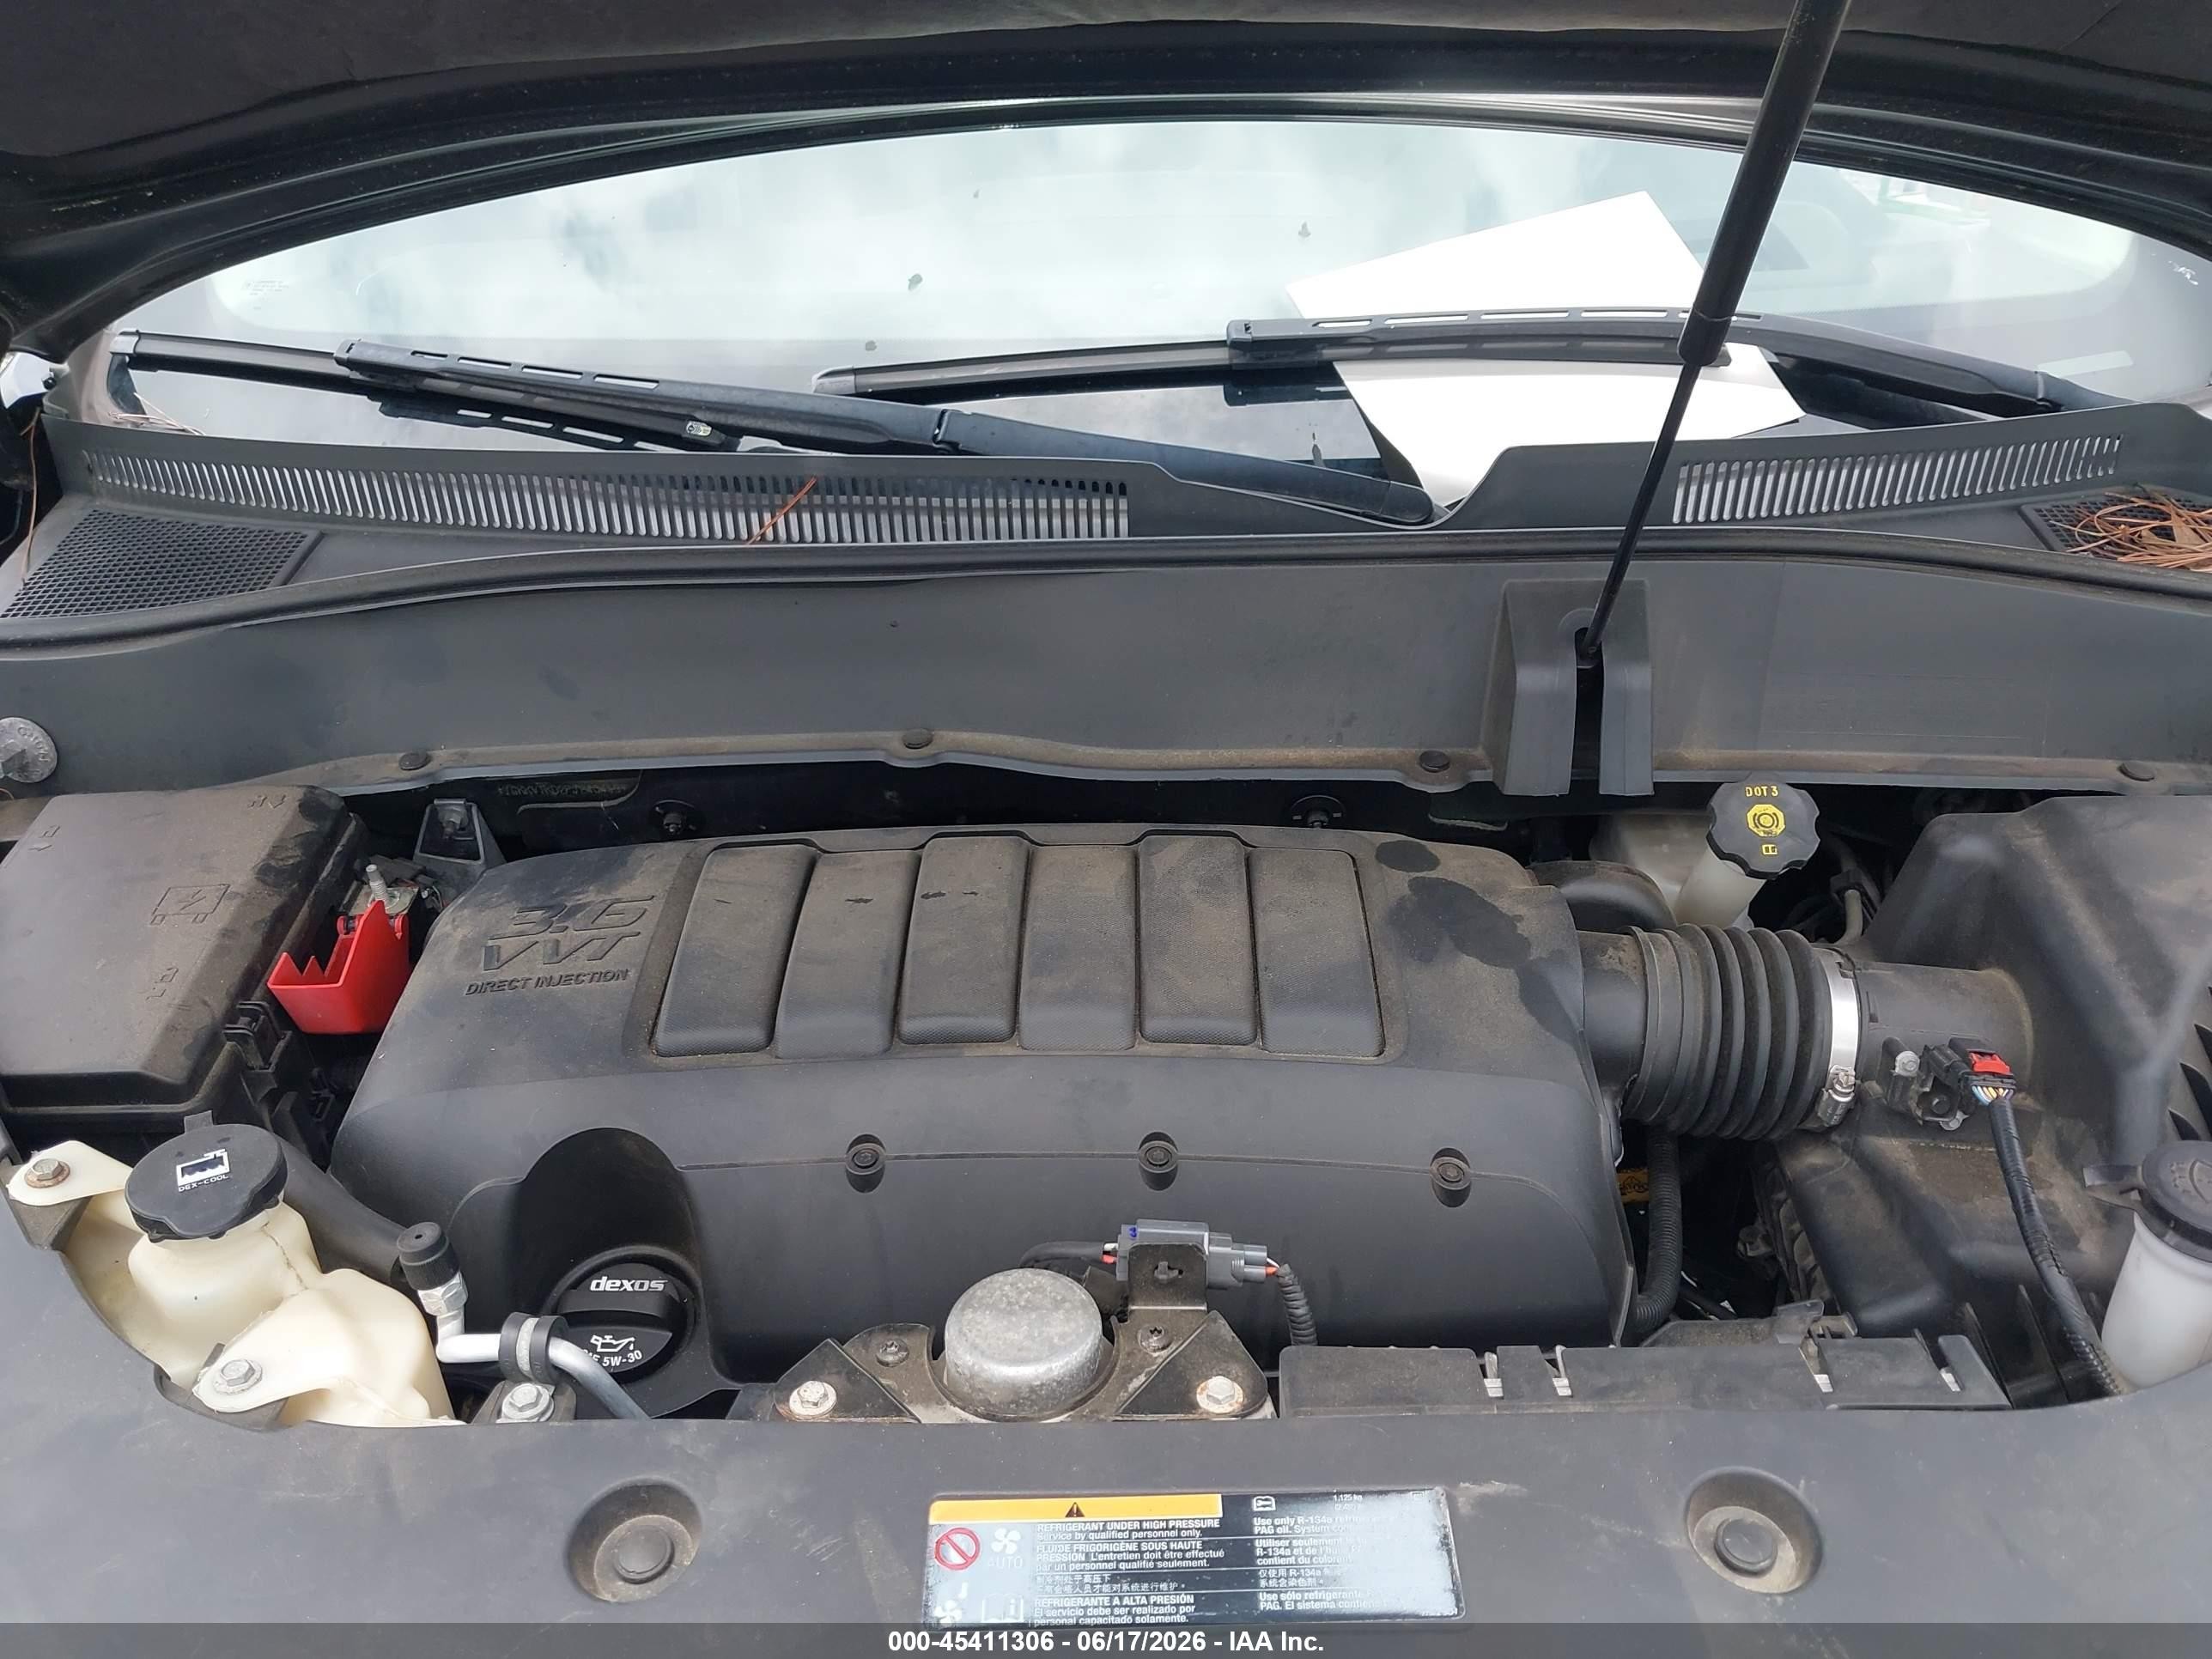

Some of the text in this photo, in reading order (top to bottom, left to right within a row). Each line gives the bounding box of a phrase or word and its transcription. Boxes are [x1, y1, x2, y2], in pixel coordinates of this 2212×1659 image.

[1745, 785, 1779, 797] DOT 3
[483, 931, 641, 972] VVT
[465, 968, 629, 996] DIRECT INJECTION
[178, 1174, 229, 1193] DEX-COOL
[590, 1276, 669, 1291] dexos
[602, 1350, 643, 1367] 5W-30
[1037, 1519, 1220, 1532] REFRIGERANT UNDER HIGH PRESSURE
[1254, 1516, 1272, 1525] Use
[1274, 1516, 1295, 1526] only
[1297, 1516, 1333, 1525] R-134a
[1075, 1532, 1085, 1540] by
[1089, 1531, 1129, 1540] qualified
[1133, 1529, 1178, 1539] personnel
[1181, 1529, 1203, 1538] only.
[1255, 1526, 1274, 1534] PAG
[1277, 1525, 1292, 1534] oil.
[1037, 1544, 1071, 1553] FLUIDE
[1141, 1541, 1168, 1551] SOUS
[1170, 1540, 1203, 1550] HAUTE
[1255, 1539, 1290, 1547] Utiliser
[1091, 1552, 1140, 1560] L'entretien
[1144, 1551, 1162, 1559] doit
[1185, 1548, 1225, 1559] effectué
[1256, 1547, 1291, 1556] R-134a
[1305, 1547, 1317, 1555] de
[1036, 1564, 1051, 1572] par
[1069, 1562, 1116, 1571] personnel
[1119, 1559, 1154, 1570] qualifié
[1157, 1559, 1210, 1568] seulement.
[1256, 1556, 1296, 1565] contient
[1297, 1555, 1310, 1564] du
[1259, 1569, 1287, 1577] 仅使用
[1289, 1568, 1322, 1577] R-134a
[1035, 1593, 1194, 1607] REFRIGERANTE A ALTA PRESIÓN
[1280, 1590, 1302, 1600] sólo
[1035, 1607, 1042, 1616] El
[1045, 1607, 1084, 1616] servicio
[1132, 1605, 1176, 1614] realizado
[1180, 1606, 1196, 1615] por
[1261, 1601, 1282, 1611] PAG.
[1285, 1601, 1295, 1610] El
[1297, 1600, 1335, 1609] sistema
[1034, 1614, 1189, 1627] personal capacitado solamente.
